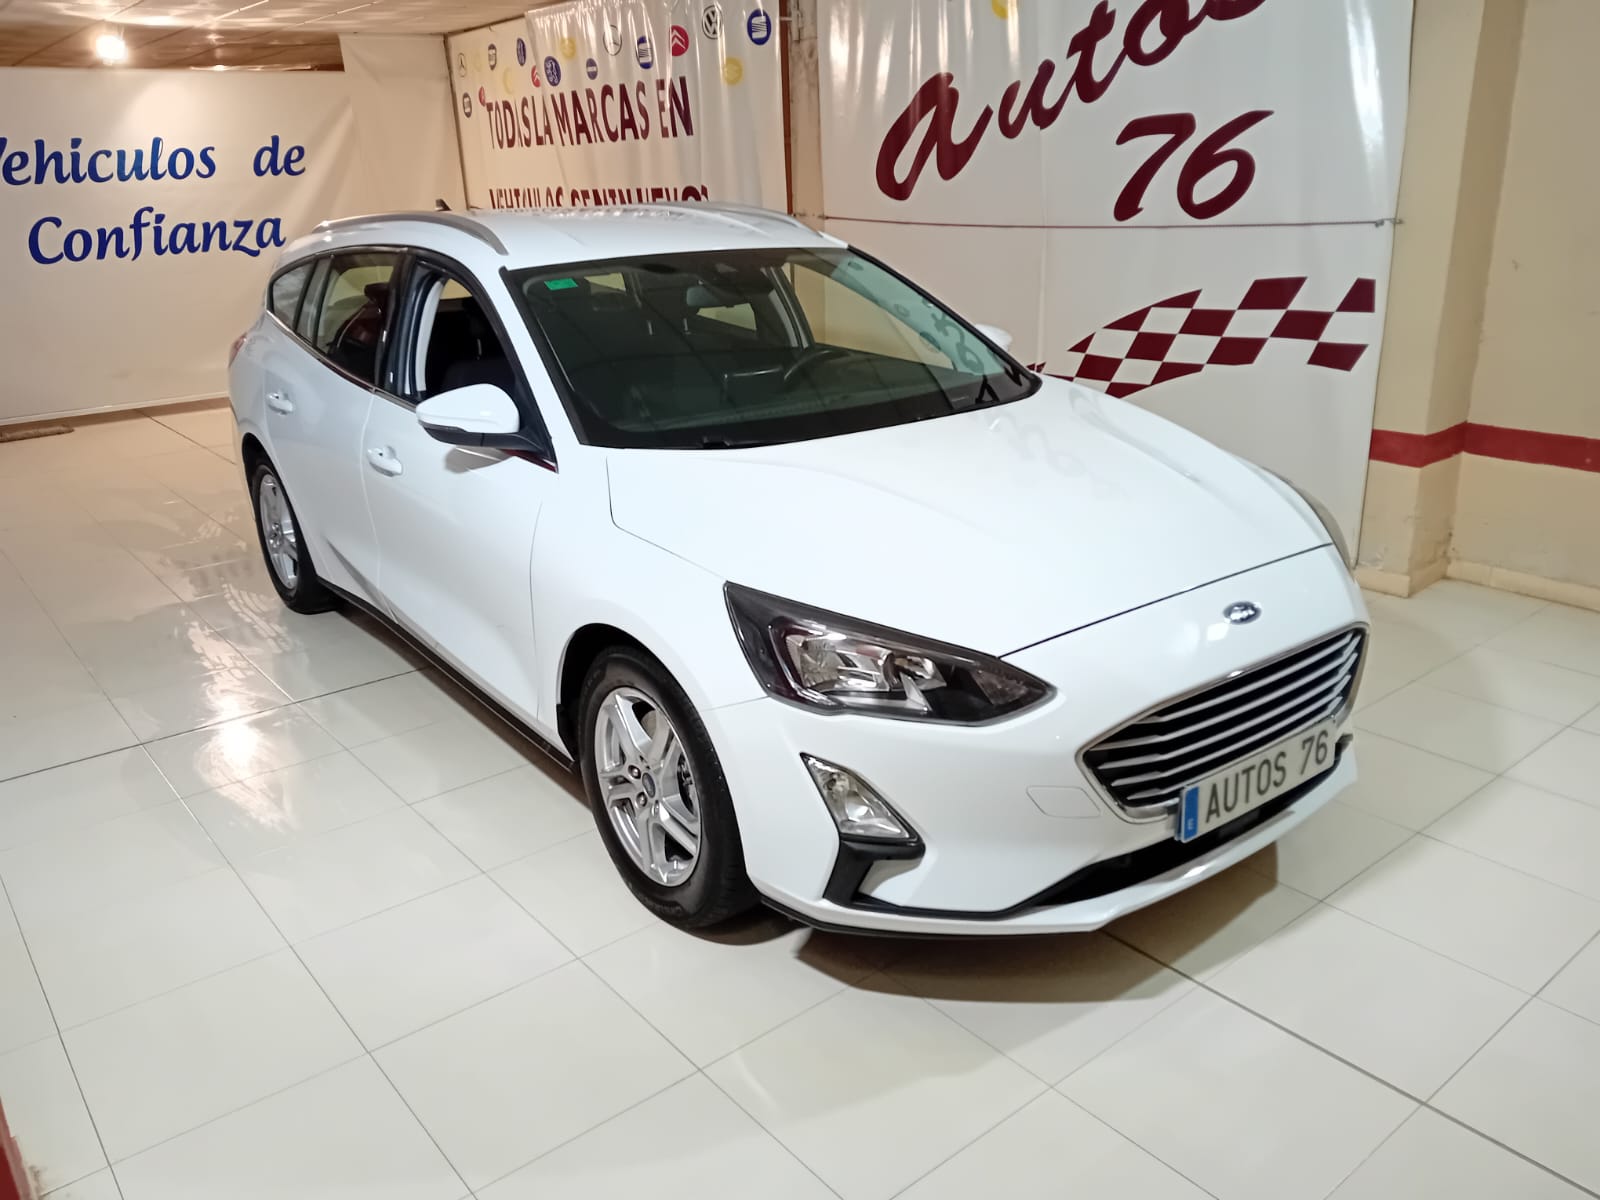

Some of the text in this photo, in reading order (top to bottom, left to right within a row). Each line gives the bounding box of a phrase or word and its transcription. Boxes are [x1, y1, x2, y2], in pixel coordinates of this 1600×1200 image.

[551, 80, 651, 147] MARCAS
[656, 75, 694, 139] EN
[252, 134, 306, 177] de
[1113, 110, 1274, 221] 76
[28, 206, 287, 265] Confianza
[1206, 751, 1287, 824] AUTOS
[1300, 729, 1329, 775] 76
